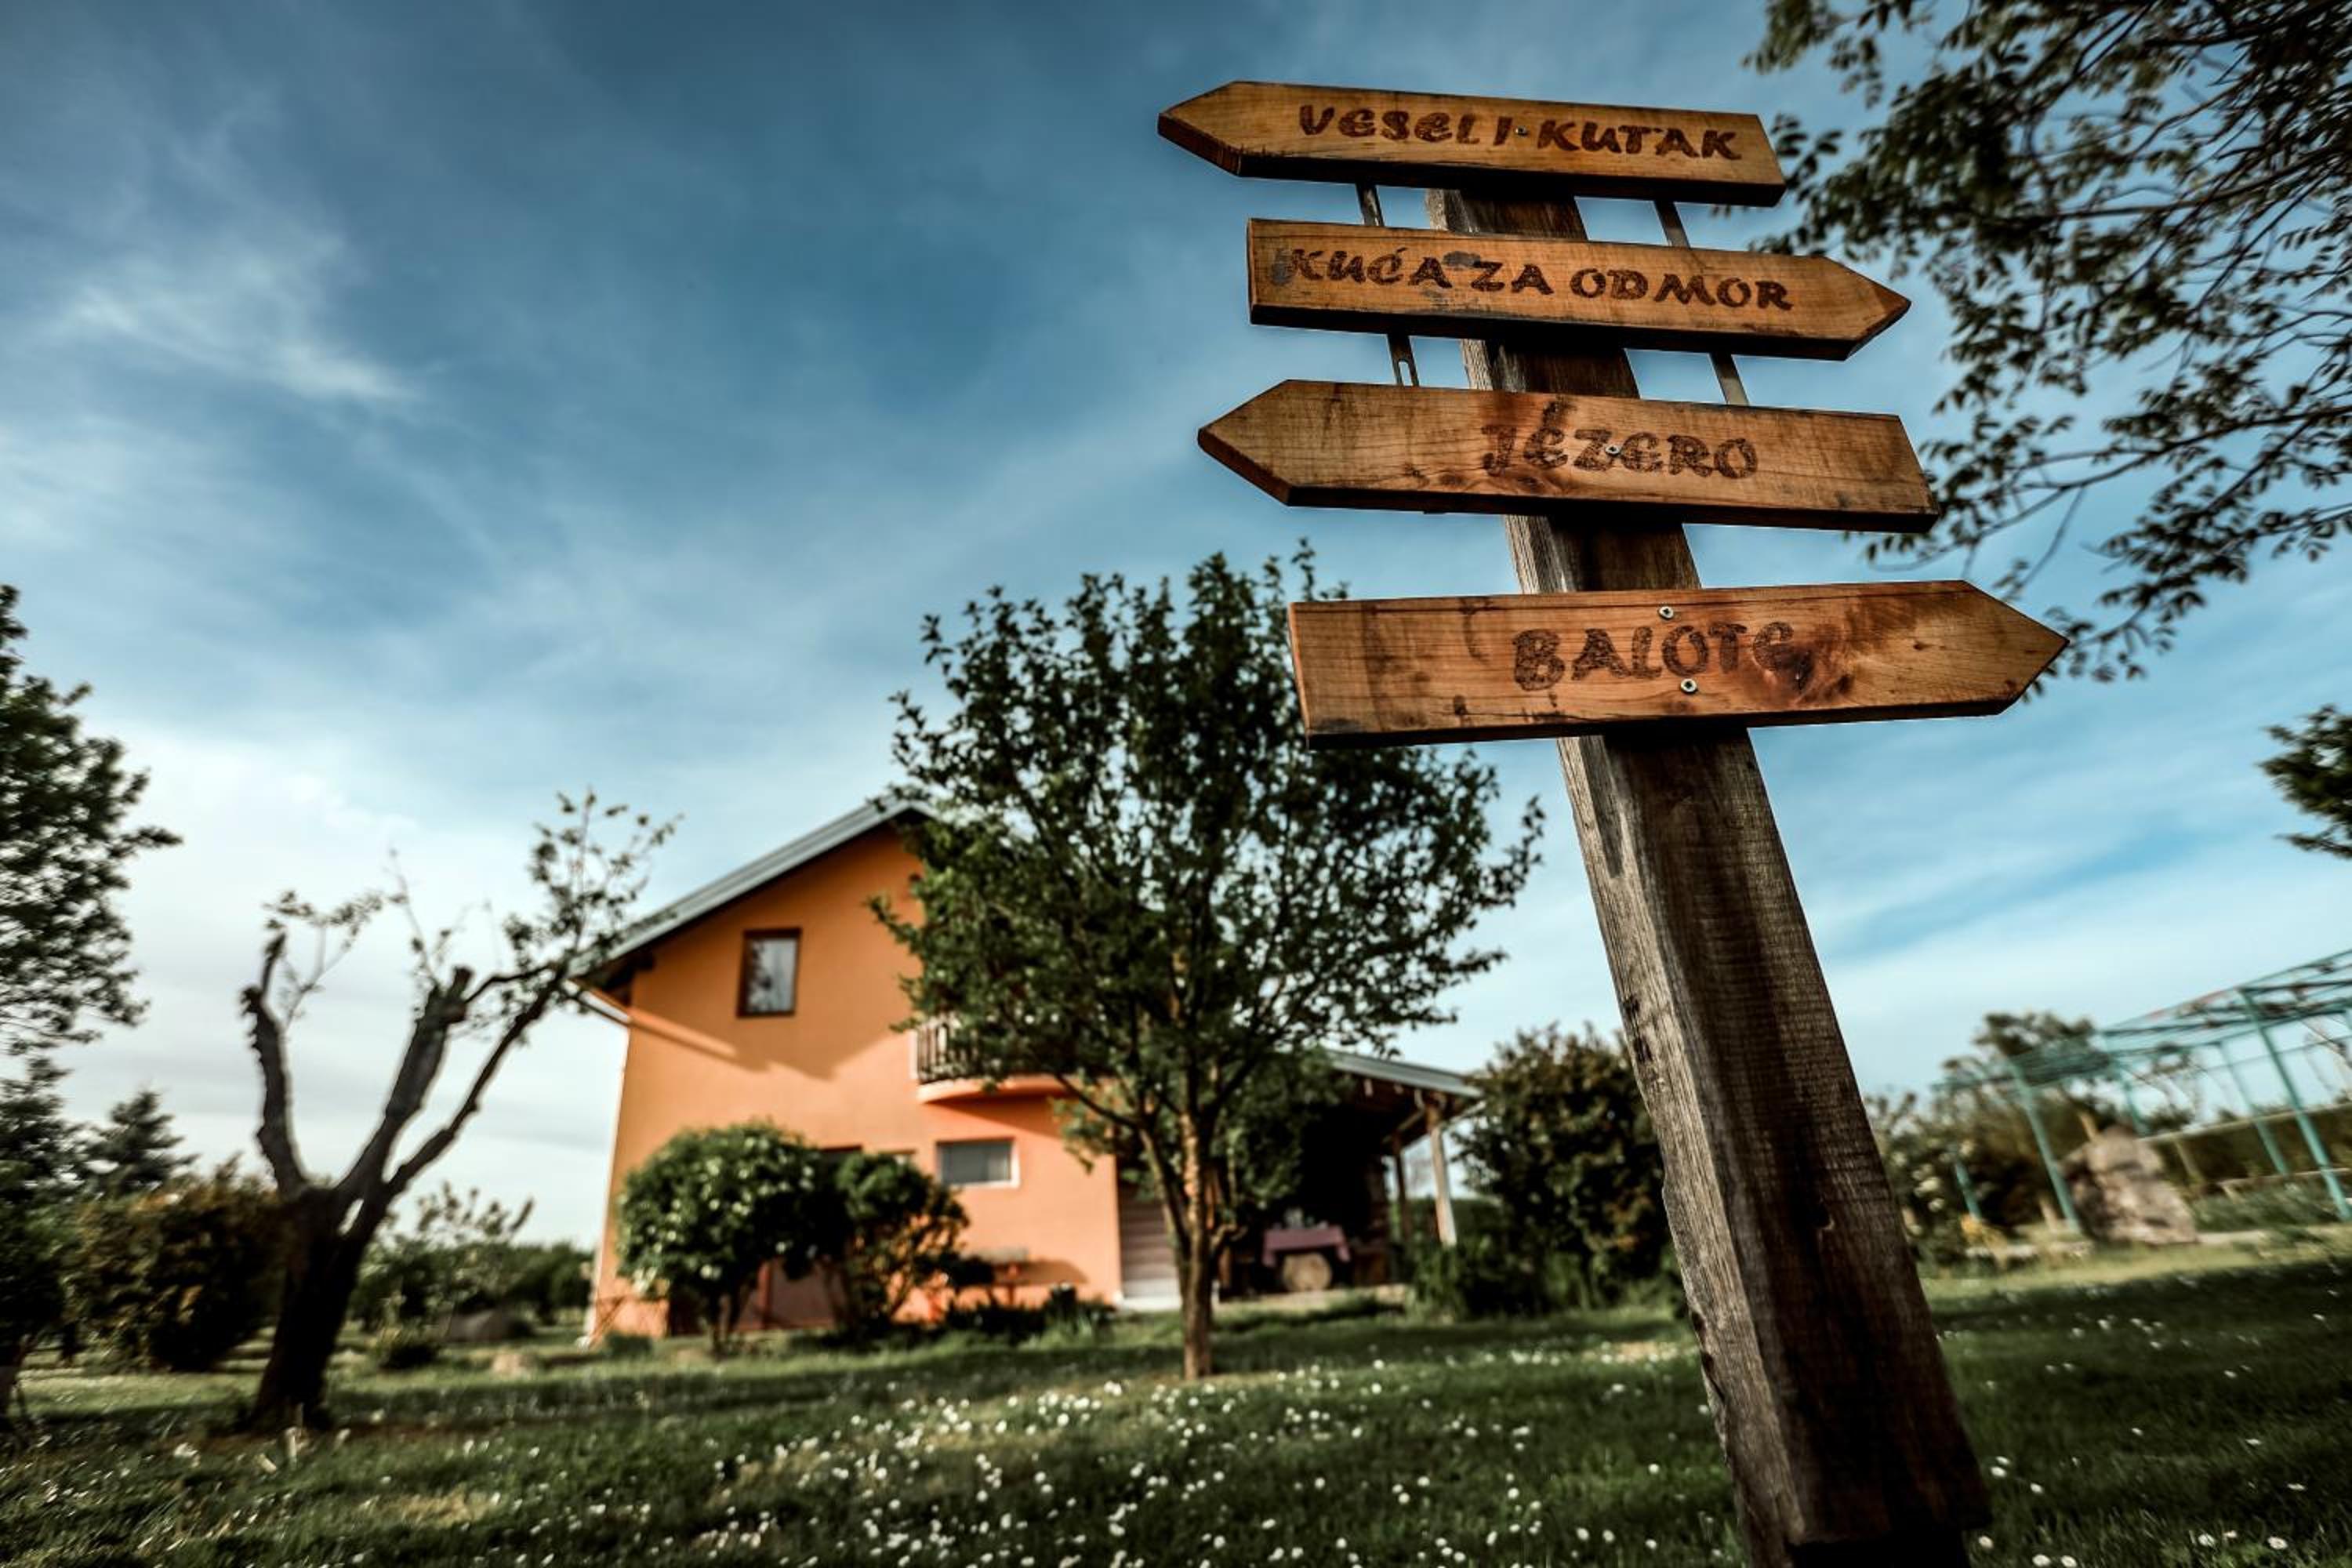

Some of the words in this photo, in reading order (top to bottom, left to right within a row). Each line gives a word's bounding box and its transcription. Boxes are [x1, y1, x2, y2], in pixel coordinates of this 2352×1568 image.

[1537, 118, 1743, 161] KUTAK
[1287, 246, 1452, 291] KUĆA
[1468, 260, 1554, 295] ZA
[1570, 267, 1794, 312] ODMOR
